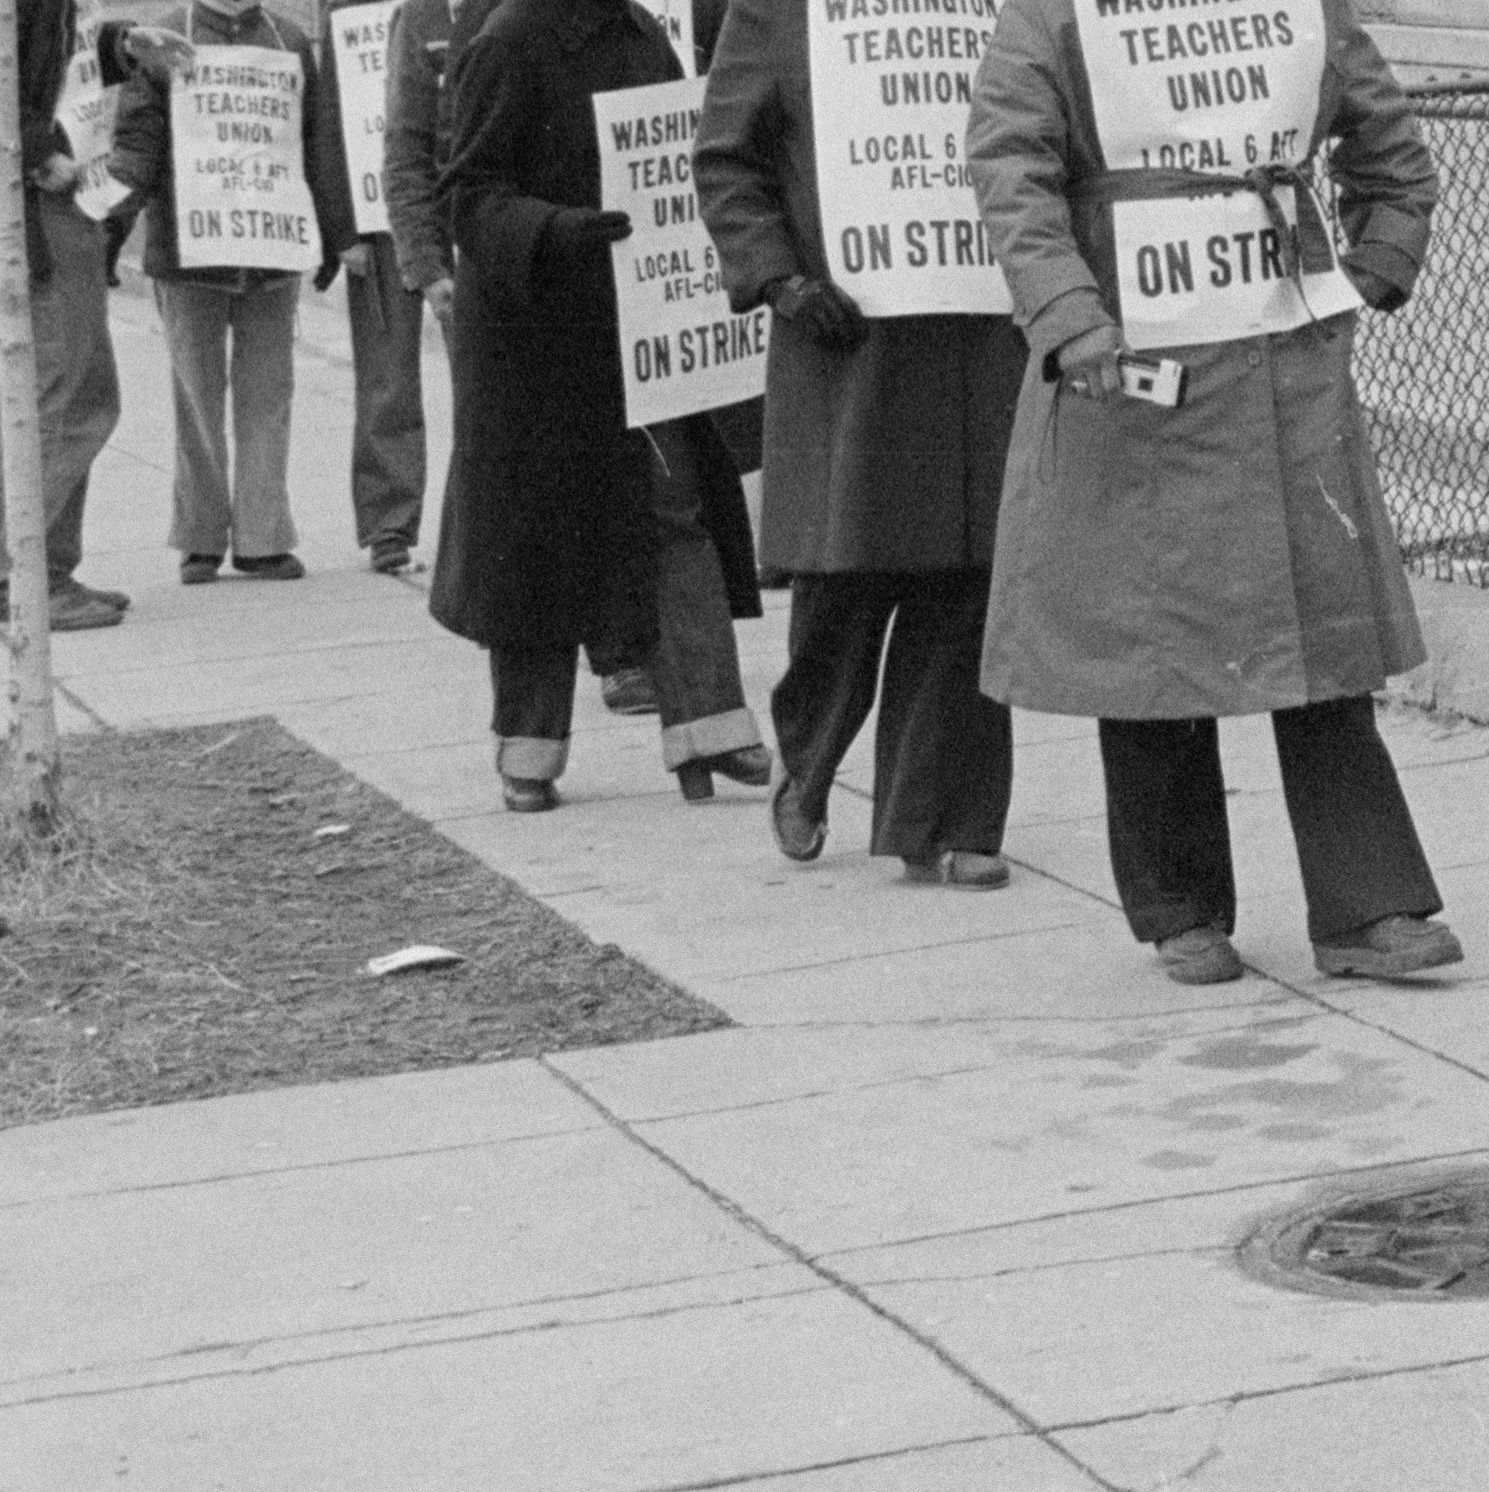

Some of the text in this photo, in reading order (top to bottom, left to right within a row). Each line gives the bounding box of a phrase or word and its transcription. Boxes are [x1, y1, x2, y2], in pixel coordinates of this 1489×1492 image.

[1119, 11, 1294, 66] TEACHERS
[194, 92, 290, 121] TEACHERS
[880, 71, 972, 106] UNION
[1167, 64, 1270, 112] UNION
[217, 121, 274, 145] UNION
[849, 132, 957, 165] LOCAL 6
[1244, 134, 1258, 164] 6
[628, 153, 690, 191] TEAC
[189, 209, 311, 246] ON STRIKE
[653, 193, 695, 228] UNI
[634, 245, 715, 282] LOCAL 6
[841, 224, 893, 274] ON
[1136, 225, 1298, 298] ON STR
[633, 311, 766, 383] ON STRIKE
